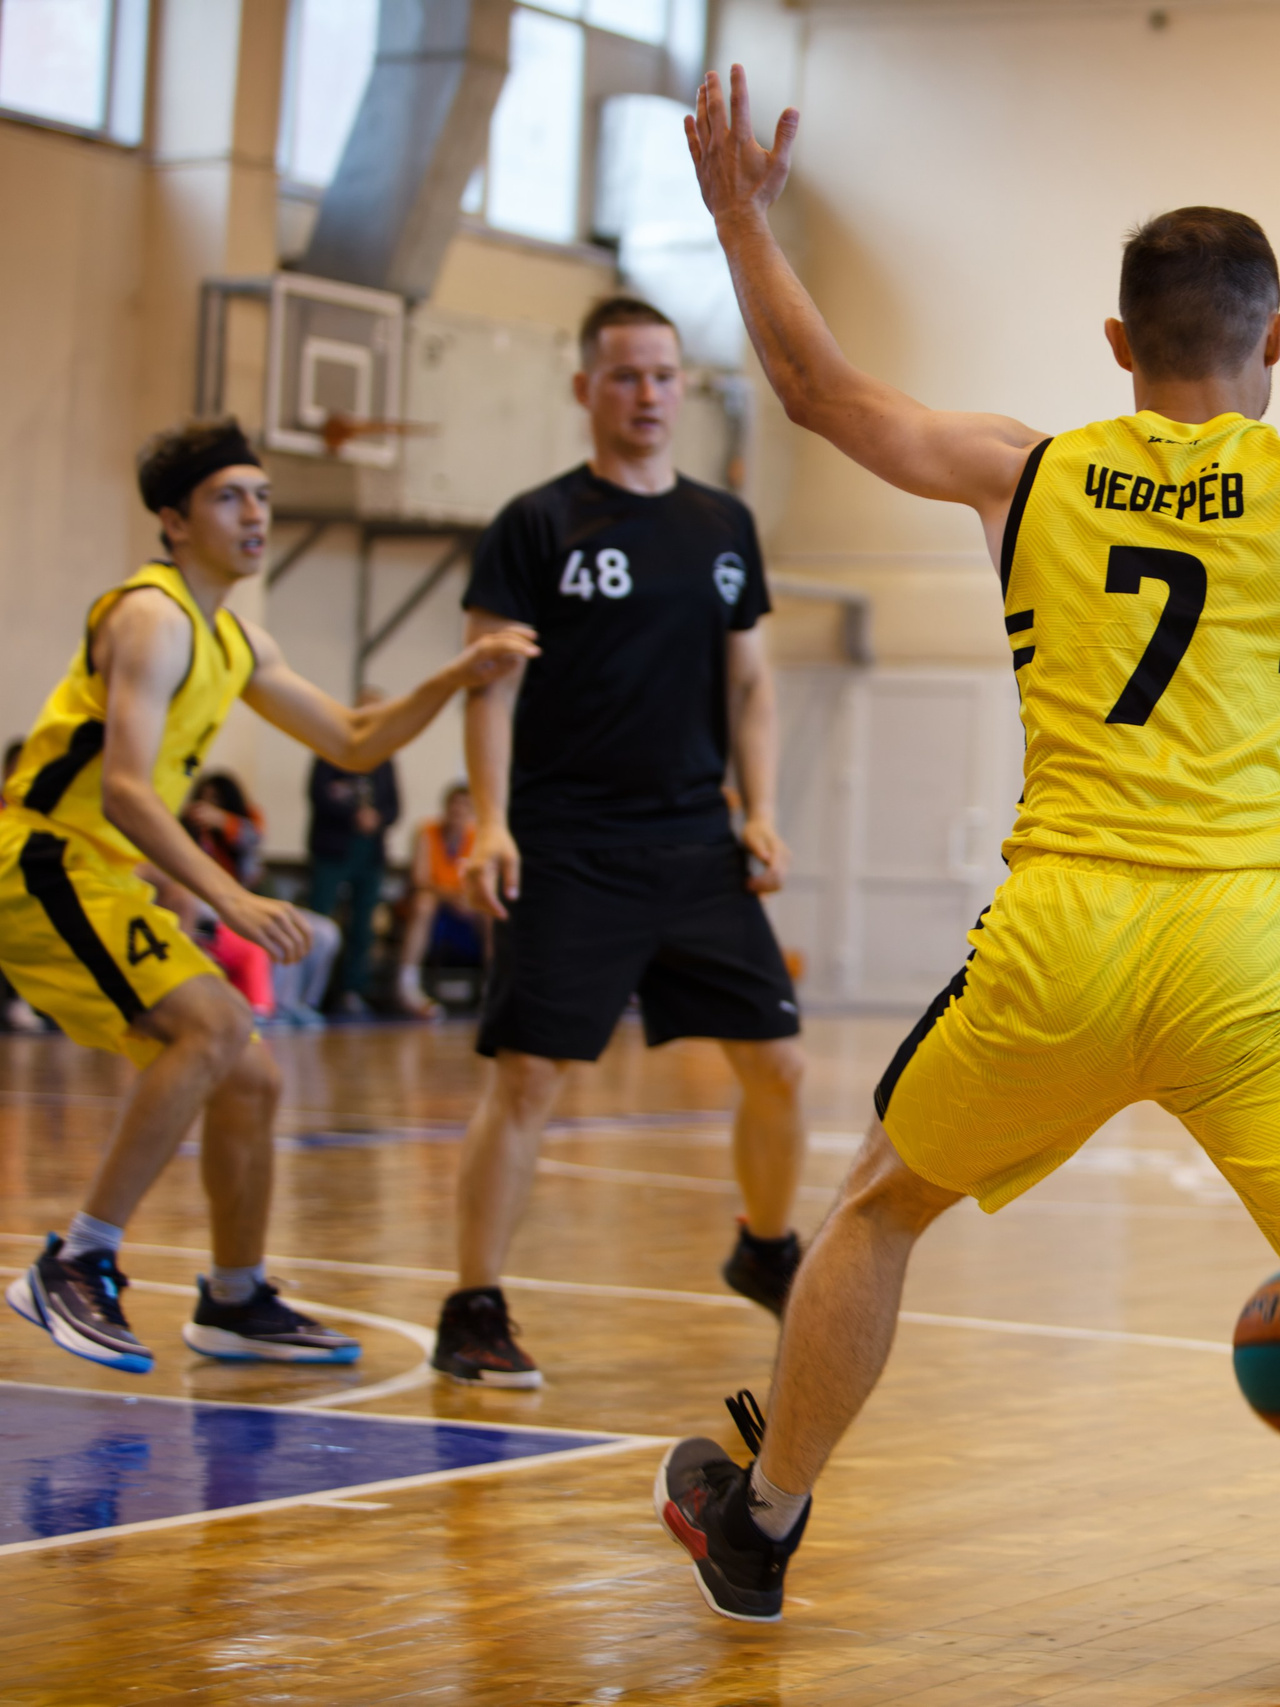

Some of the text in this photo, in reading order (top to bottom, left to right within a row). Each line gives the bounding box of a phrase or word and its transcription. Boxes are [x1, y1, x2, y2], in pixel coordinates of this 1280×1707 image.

[1085, 462, 1244, 522] ЧЕВЕРЁВ
[559, 548, 632, 600] 48
[1105, 545, 1207, 726] 7
[127, 916, 170, 966] 4
